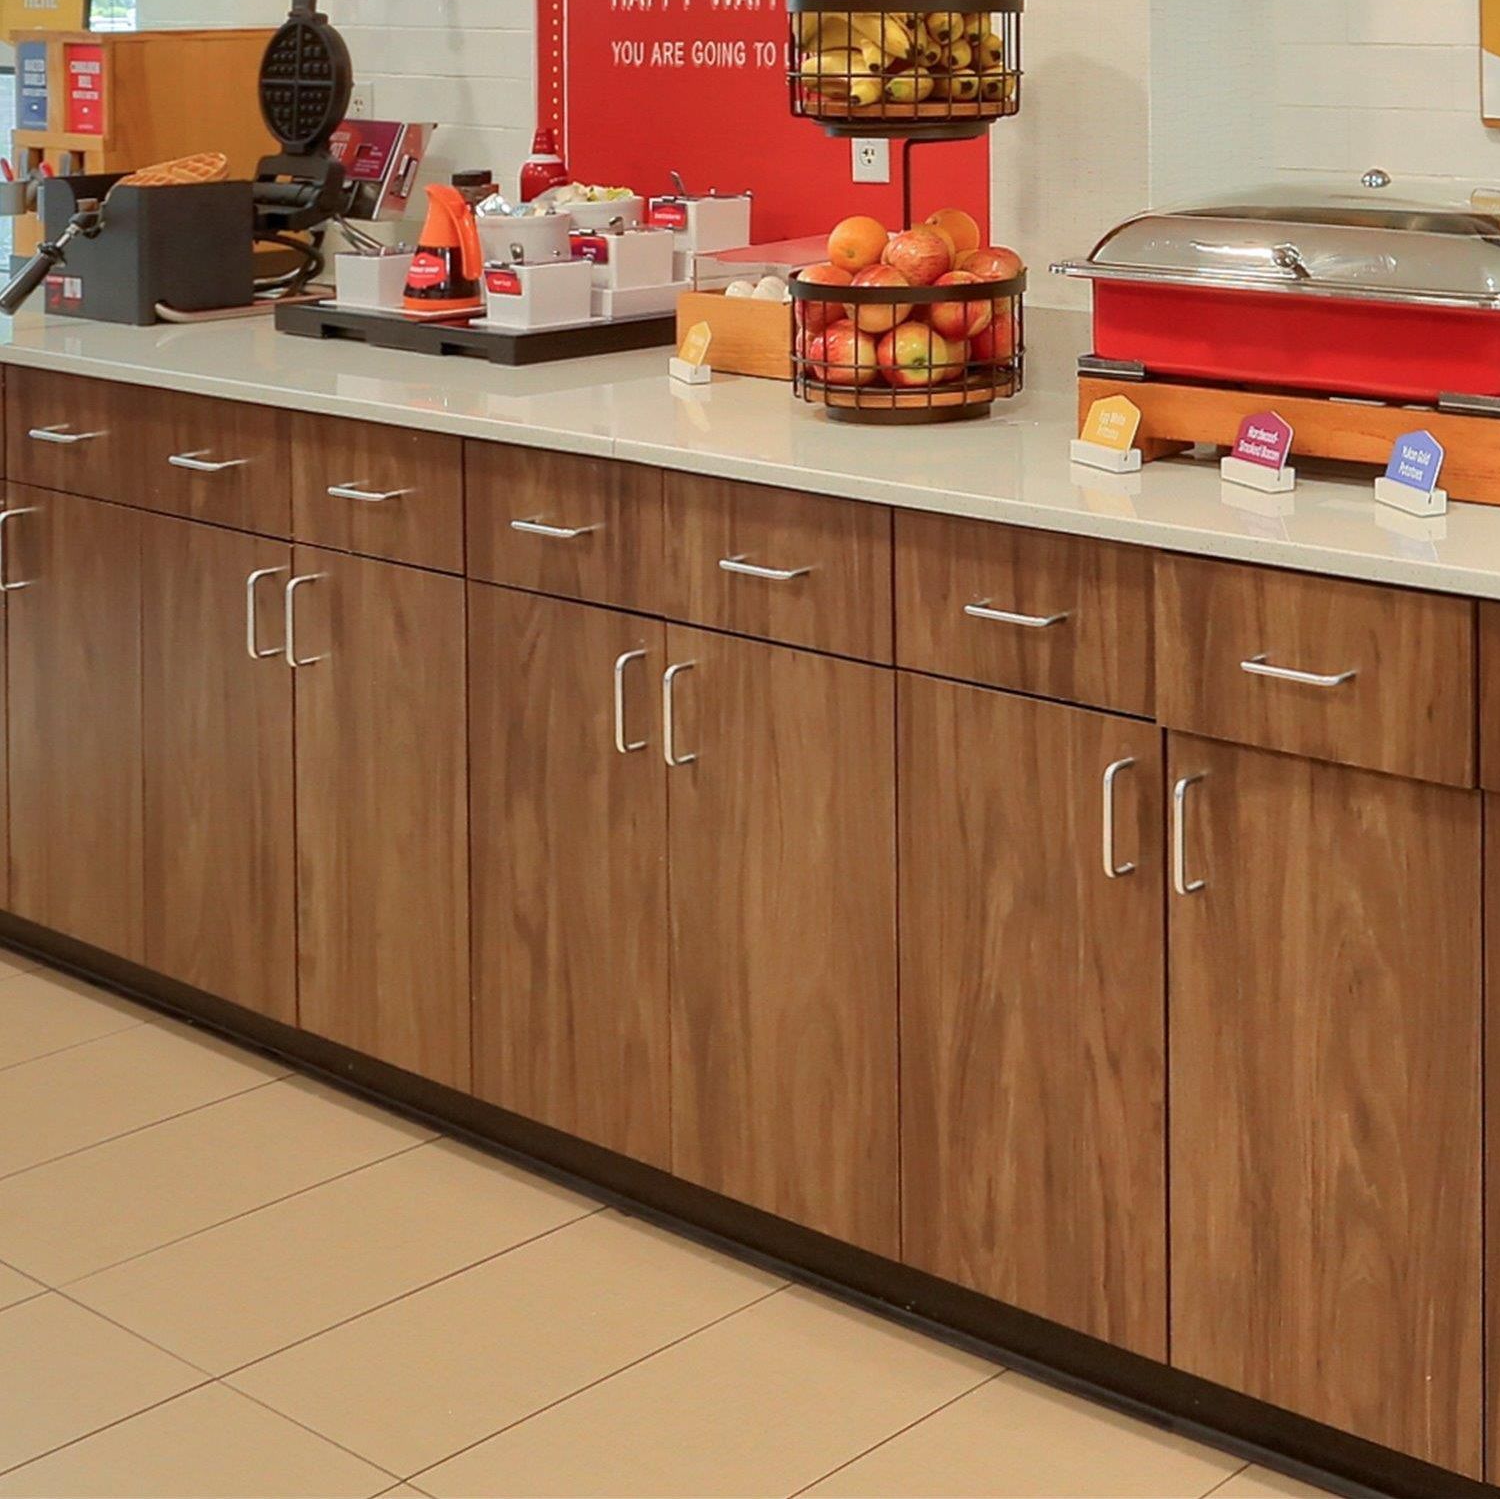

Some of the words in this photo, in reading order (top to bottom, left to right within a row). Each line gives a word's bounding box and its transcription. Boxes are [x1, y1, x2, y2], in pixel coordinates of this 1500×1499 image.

[611, 41, 644, 68] YOU
[650, 41, 685, 68] ARE
[691, 40, 746, 69] GOING
[754, 42, 776, 68] TO
